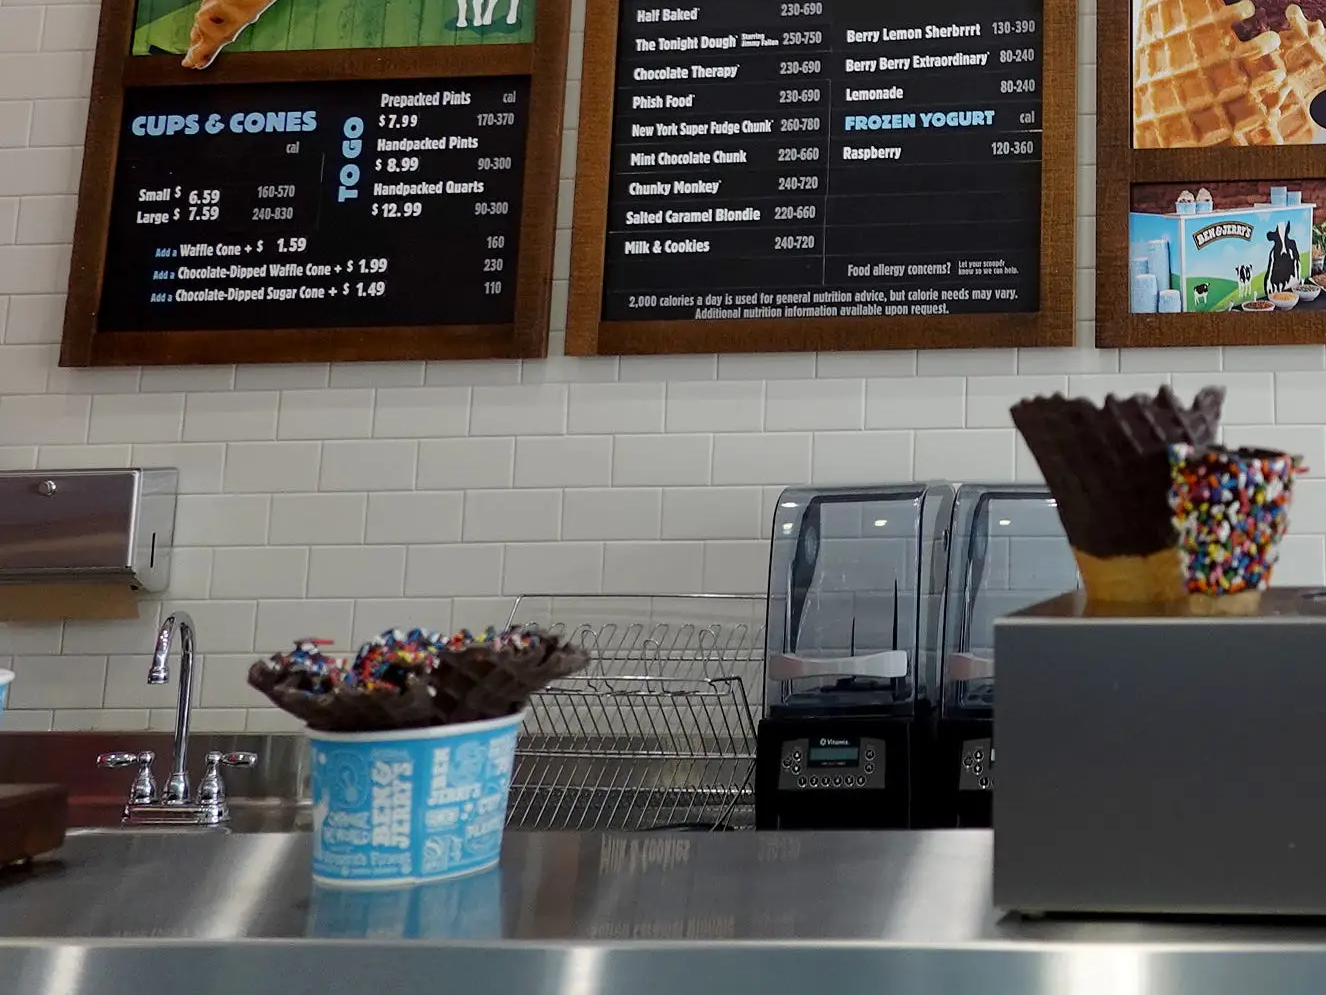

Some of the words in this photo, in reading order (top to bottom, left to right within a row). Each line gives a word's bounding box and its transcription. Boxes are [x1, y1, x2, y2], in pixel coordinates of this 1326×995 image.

[847, 30, 879, 42] Berry
[883, 28, 922, 40] Lemon
[925, 24, 980, 38] Sherbrrrt
[992, 20, 1035, 34] 130-390
[381, 92, 440, 108] Prepacked
[443, 91, 471, 105] Pints
[503, 91, 516, 103] cal
[132, 114, 199, 136] CUPS
[205, 114, 225, 134] &
[230, 111, 317, 133] CONES
[845, 114, 915, 130] FROZEN
[920, 111, 995, 127] YOGURT
[1020, 111, 1034, 123] cal
[342, 117, 364, 158] GO
[377, 137, 446, 151] Handpacked
[449, 136, 478, 149] Pints
[286, 141, 299, 153] cal
[843, 146, 901, 160] Raspberry
[992, 141, 1033, 155] 120-360
[631, 153, 655, 166] Mint
[658, 152, 710, 165] Chocolate
[713, 150, 746, 163] Chunk
[778, 148, 819, 161] 220-660
[338, 164, 360, 202] TO
[374, 181, 443, 196] Handpacked
[446, 181, 484, 193] Quarts
[139, 189, 170, 201] Small
[175, 186, 181, 198] $
[189, 190, 220, 204] 6.59
[258, 185, 295, 198] 160-570
[137, 211, 169, 224] Large
[173, 208, 180, 220] $
[189, 206, 219, 220] 7.59
[252, 207, 293, 220] 240-830
[626, 211, 663, 224] Salted
[665, 209, 712, 223] Caramel
[716, 208, 760, 221] Blondie
[775, 206, 815, 219] 220-660
[625, 241, 650, 254] Milk
[653, 241, 662, 253] &
[665, 239, 709, 253] Cookies
[775, 236, 814, 249] 240-720
[848, 264, 870, 276] Food
[873, 264, 905, 276] allergy
[908, 262, 951, 275] concerns?
[695, 304, 741, 319] Additional
[744, 305, 781, 317] nutrition
[784, 303, 837, 317] information
[840, 303, 882, 316] available
[885, 305, 908, 317] upon
[910, 302, 949, 315] request.
